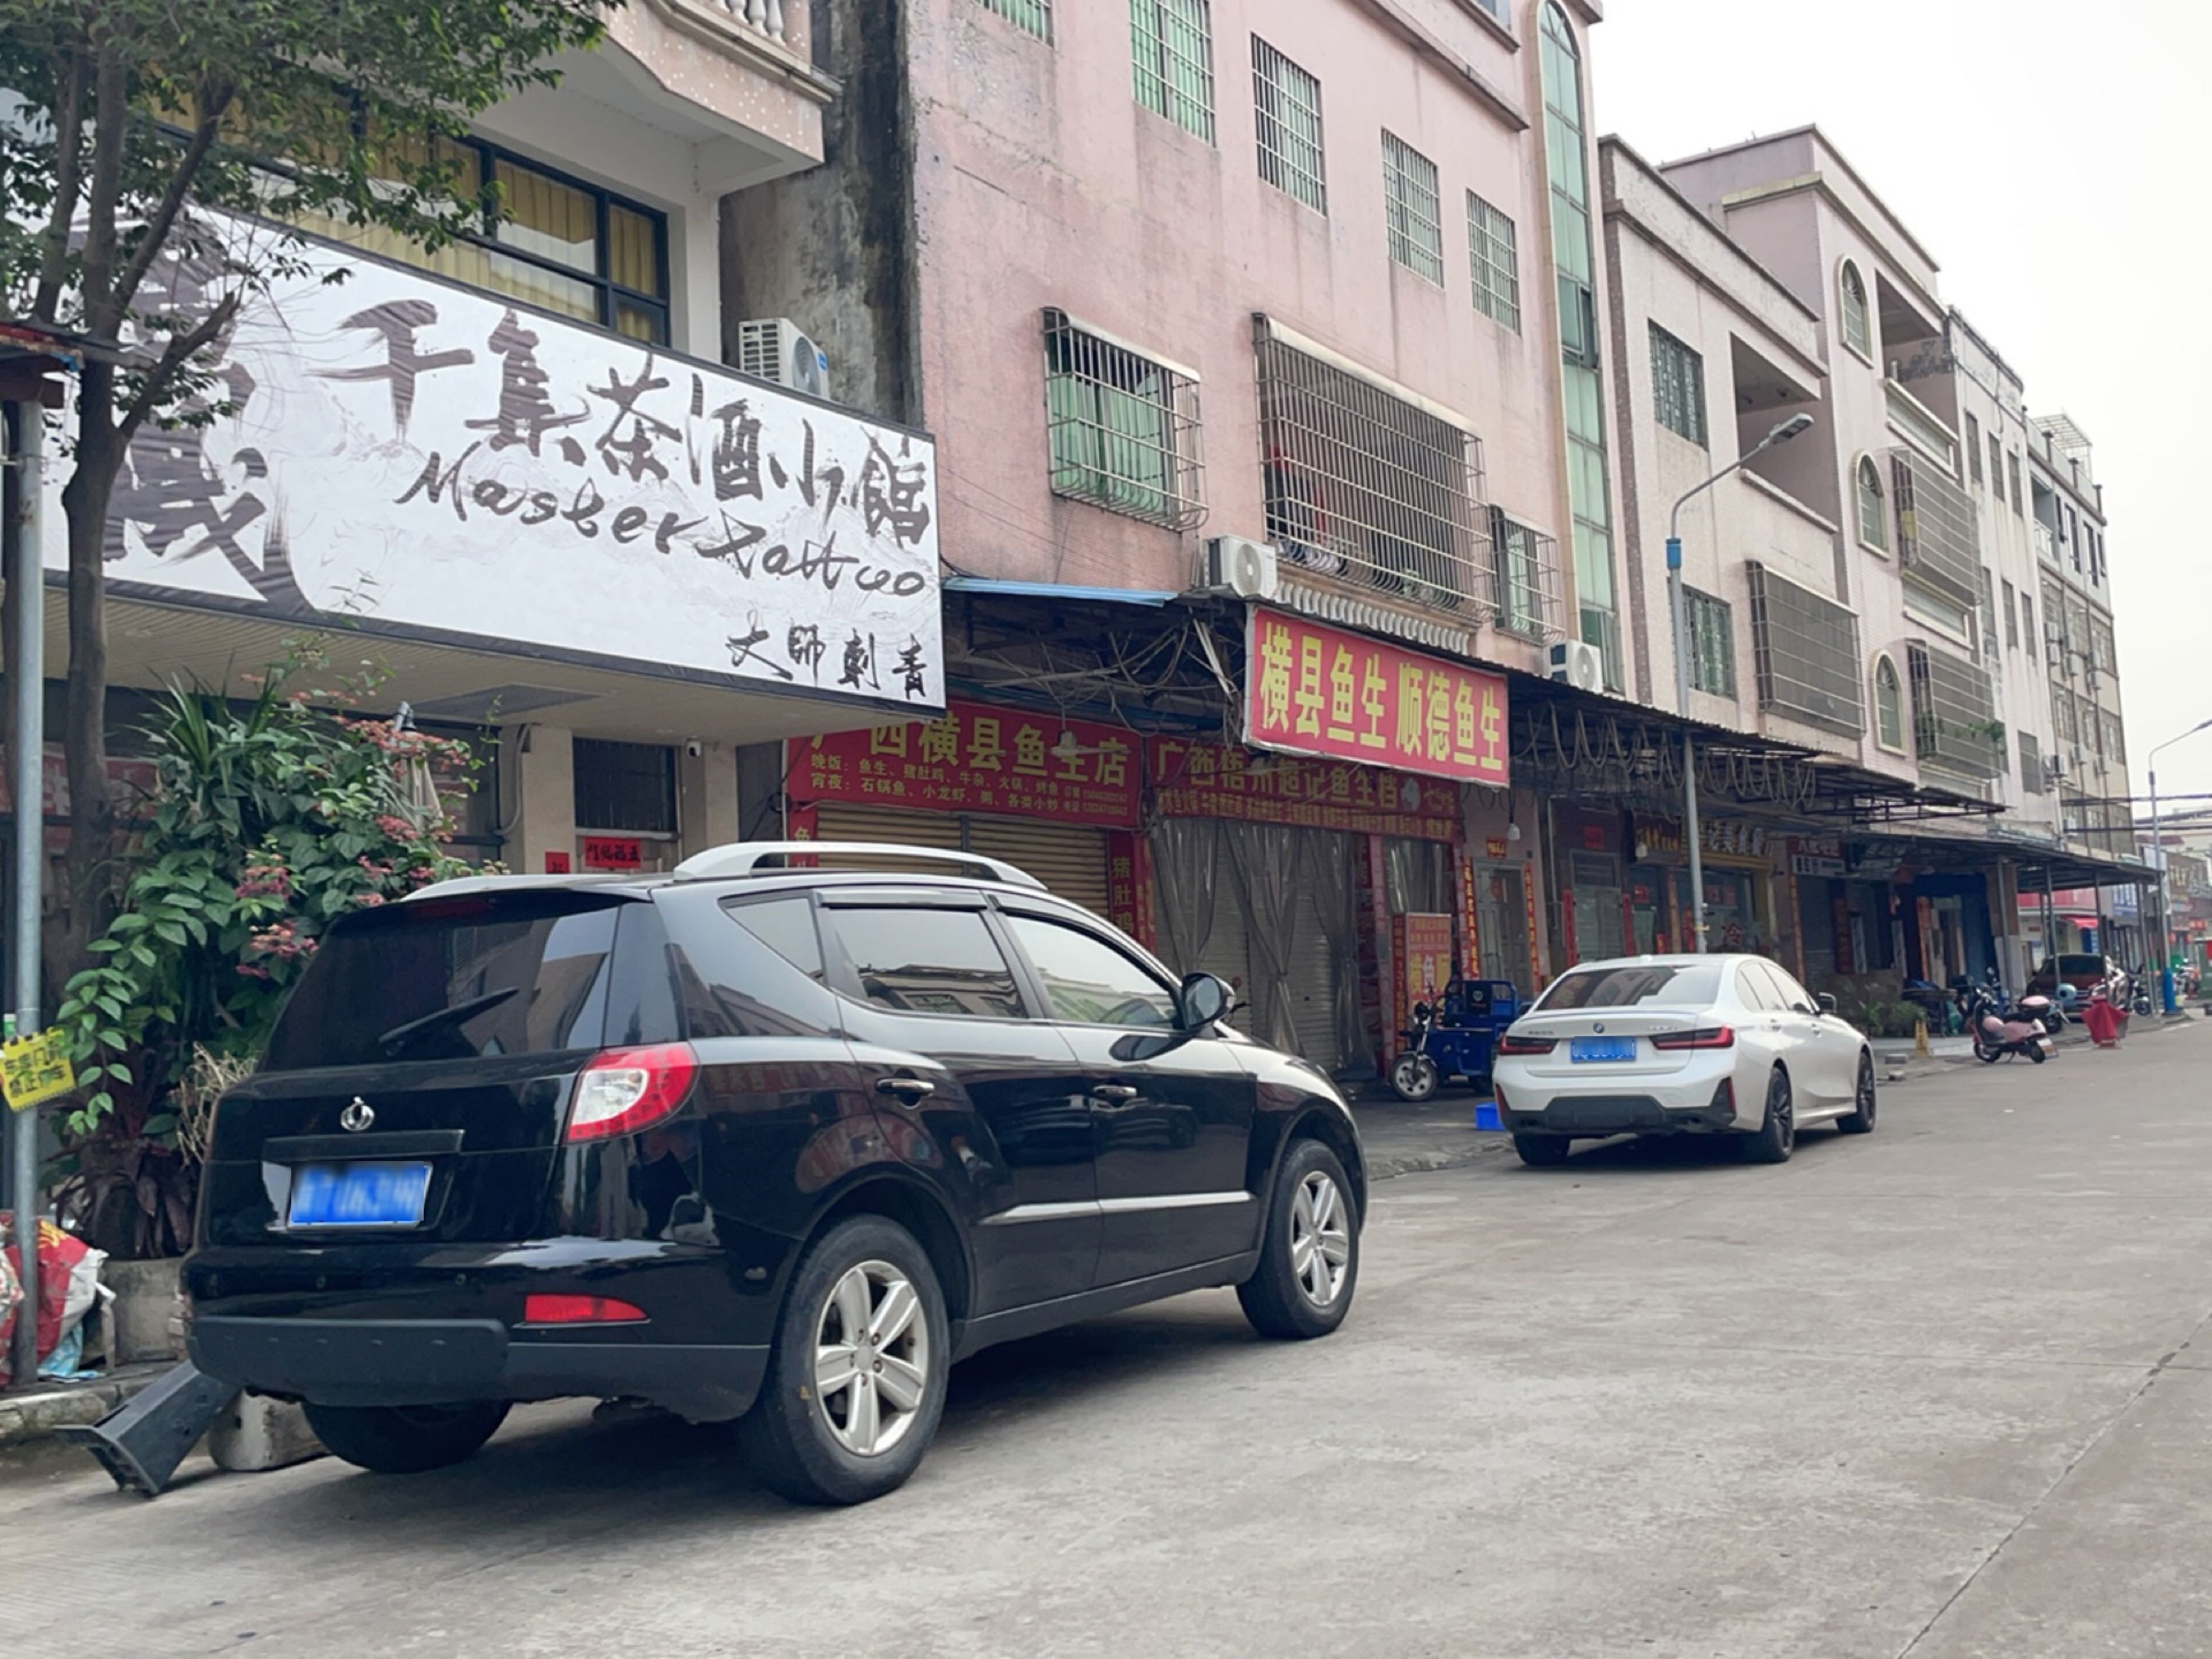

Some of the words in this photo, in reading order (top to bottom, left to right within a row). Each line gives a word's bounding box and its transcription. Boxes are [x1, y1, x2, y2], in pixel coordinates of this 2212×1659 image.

[395, 442, 708, 555] Master
[1260, 621, 1388, 749] 横县鱼生
[1396, 662, 1503, 772] 顺德鱼生
